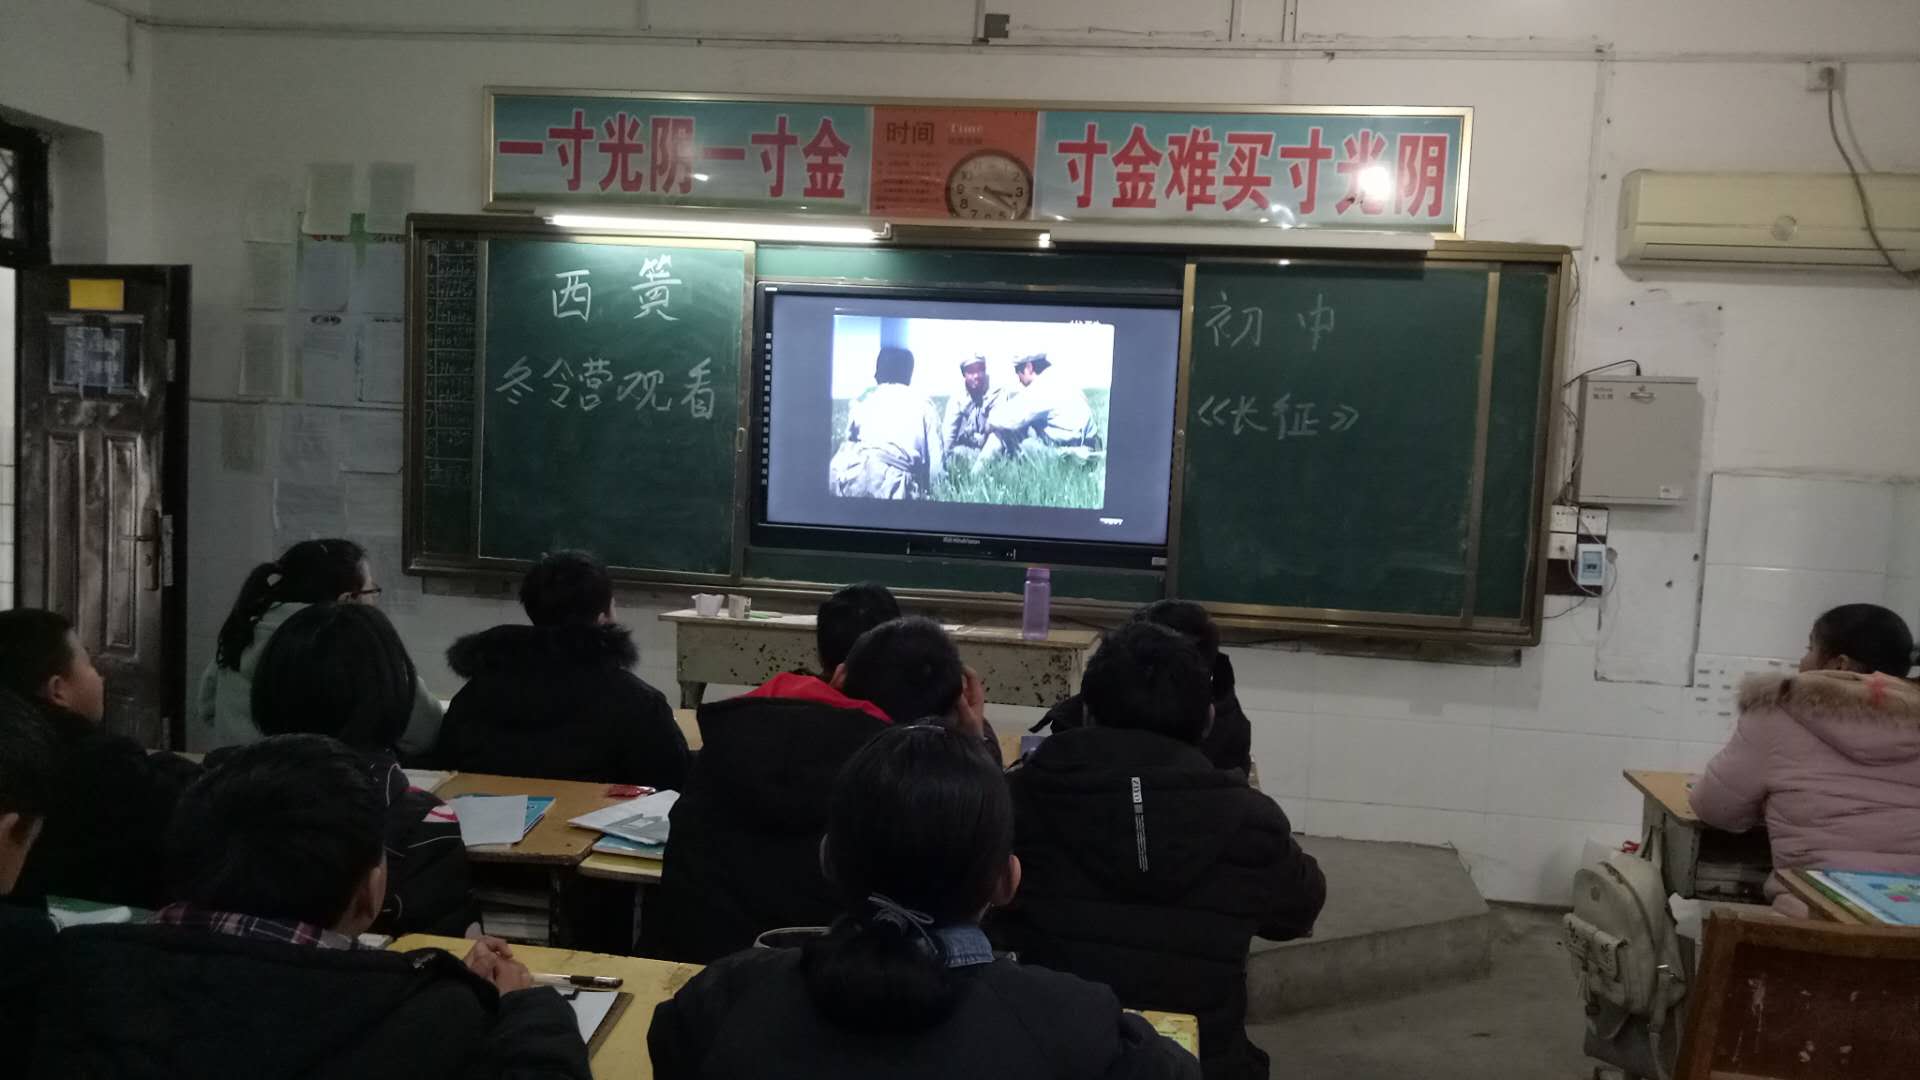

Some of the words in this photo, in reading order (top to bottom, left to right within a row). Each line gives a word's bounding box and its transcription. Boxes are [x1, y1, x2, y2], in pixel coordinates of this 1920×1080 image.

[498, 108, 851, 199] 一寸光阴一寸金
[886, 120, 935, 145] 时间
[1015, 187, 1024, 198] 3
[1057, 121, 1450, 217] 寸金难买寸光阴
[495, 355, 714, 420] 冬令营观看
[1198, 393, 1360, 440] 《长征》
